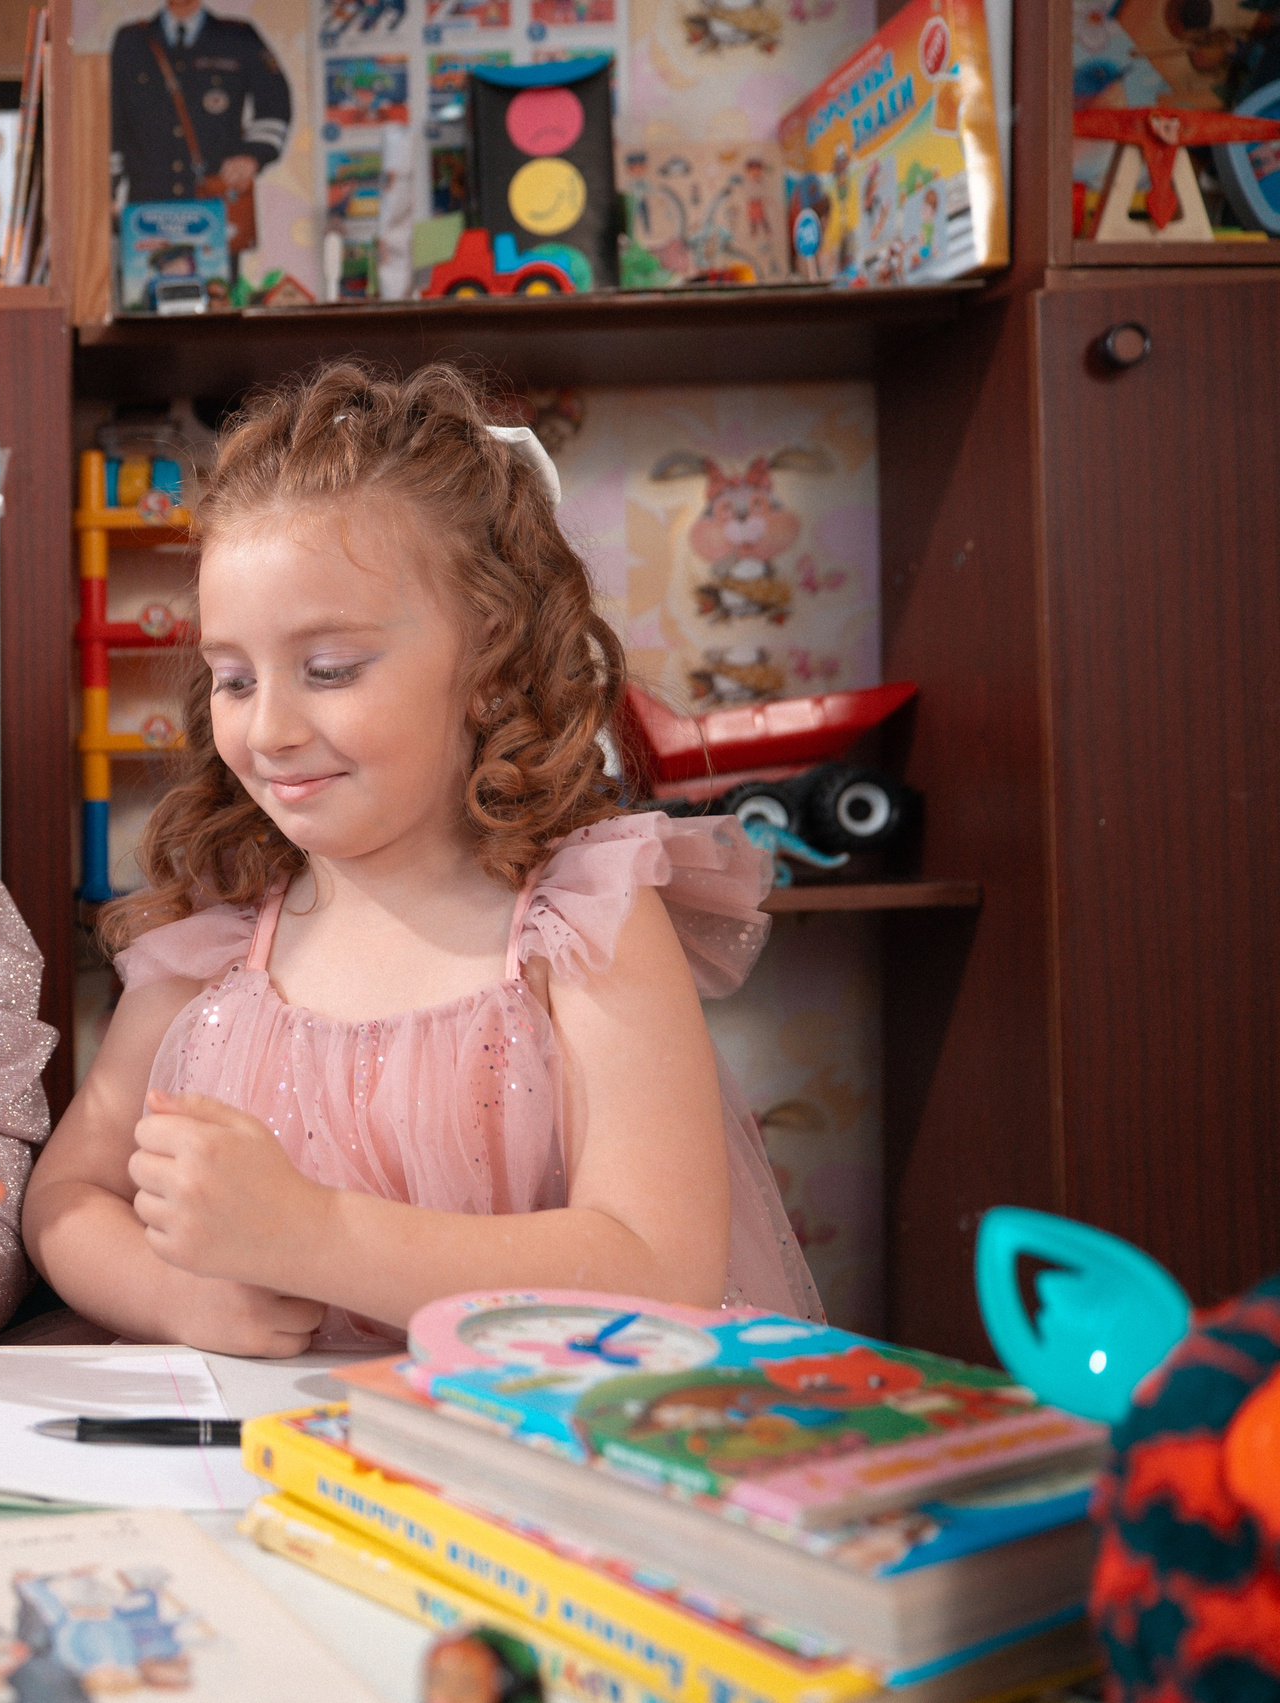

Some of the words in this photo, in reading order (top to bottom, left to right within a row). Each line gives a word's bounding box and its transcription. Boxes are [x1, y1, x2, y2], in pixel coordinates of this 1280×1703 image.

[805, 50, 894, 147] ДОРОЖНЫЕ
[850, 72, 916, 151] ЗНАКИ
[446, 1541, 548, 1617] Сказки
